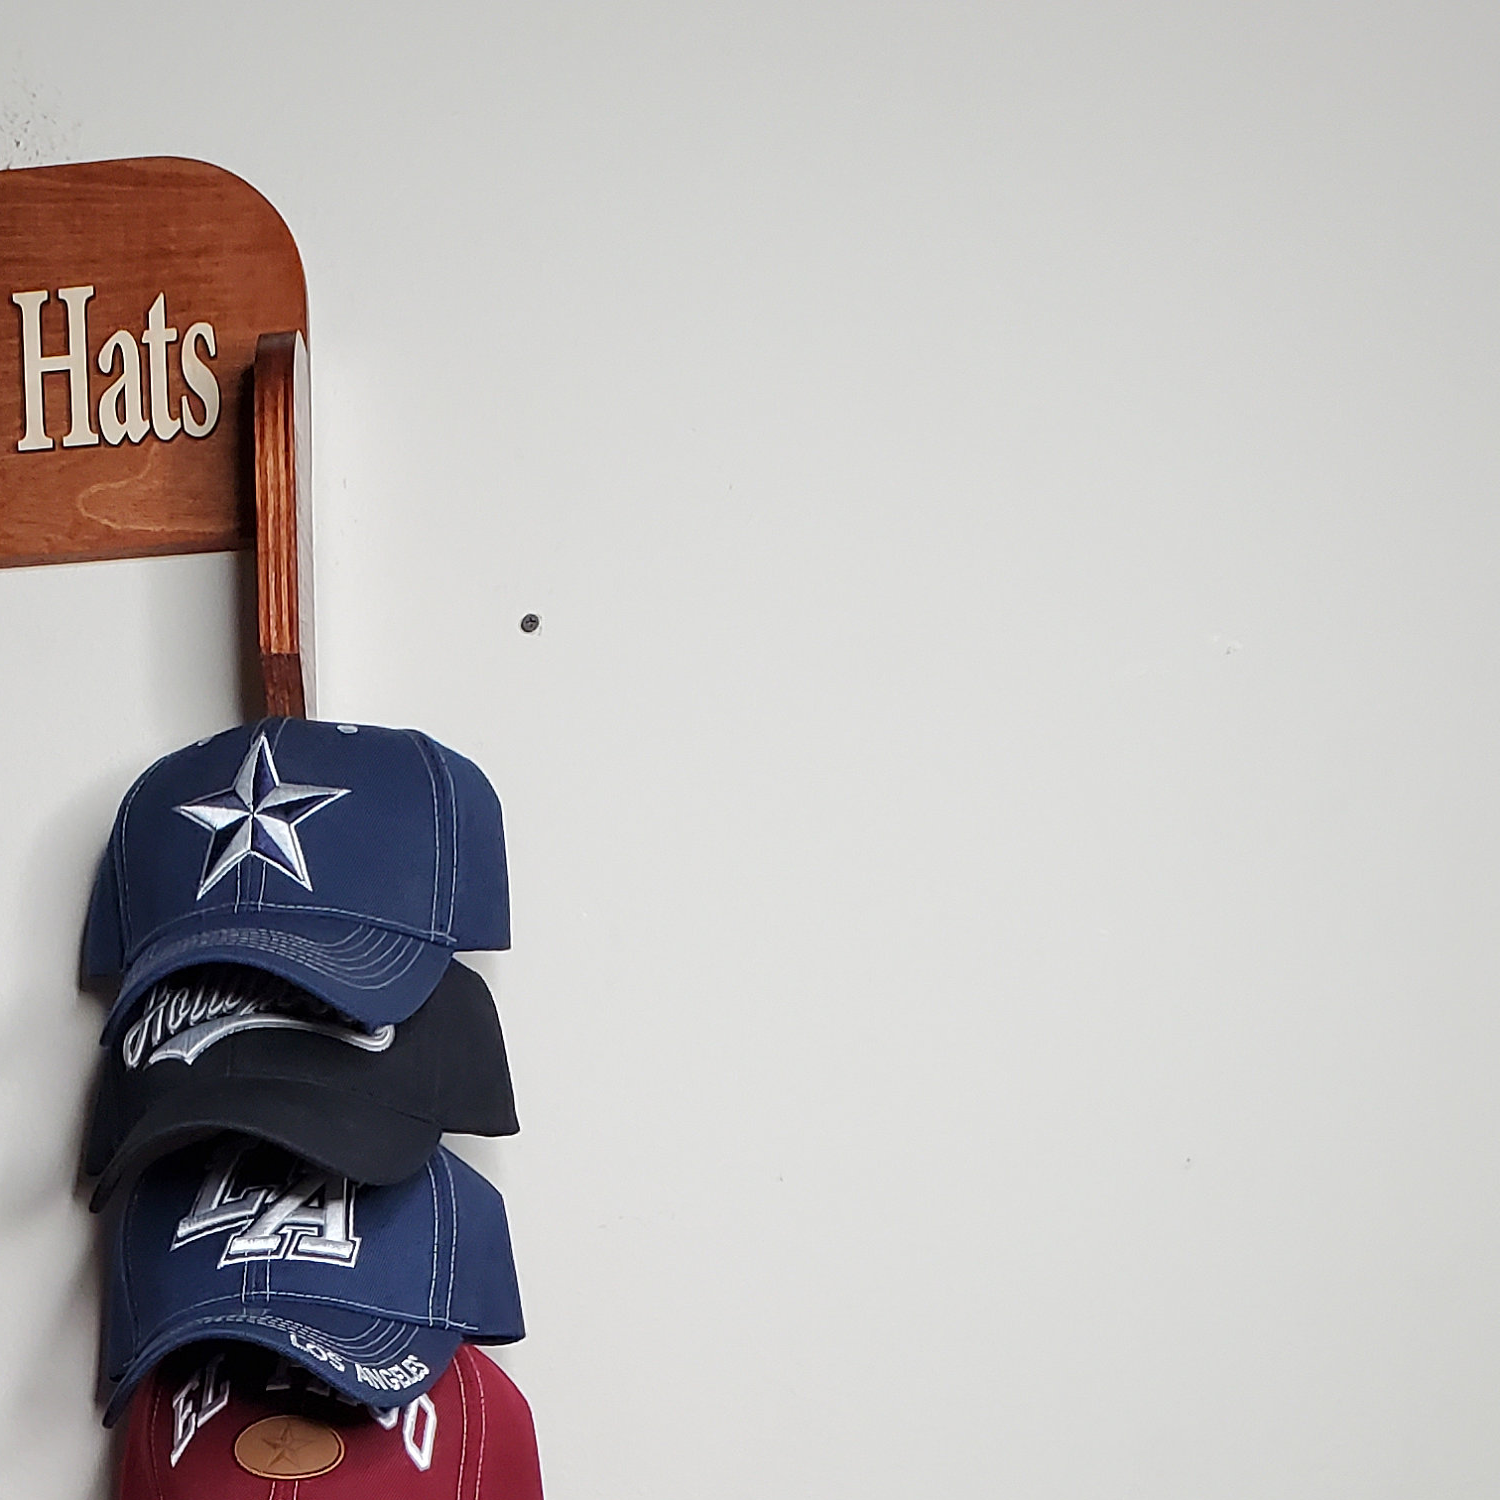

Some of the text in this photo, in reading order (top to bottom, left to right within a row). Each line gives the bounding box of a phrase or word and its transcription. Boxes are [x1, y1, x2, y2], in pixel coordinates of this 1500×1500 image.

[11, 285, 221, 455] Hats
[169, 1138, 363, 1270] LA
[289, 1332, 346, 1373] LOS
[354, 1353, 431, 1392] ANGELES
